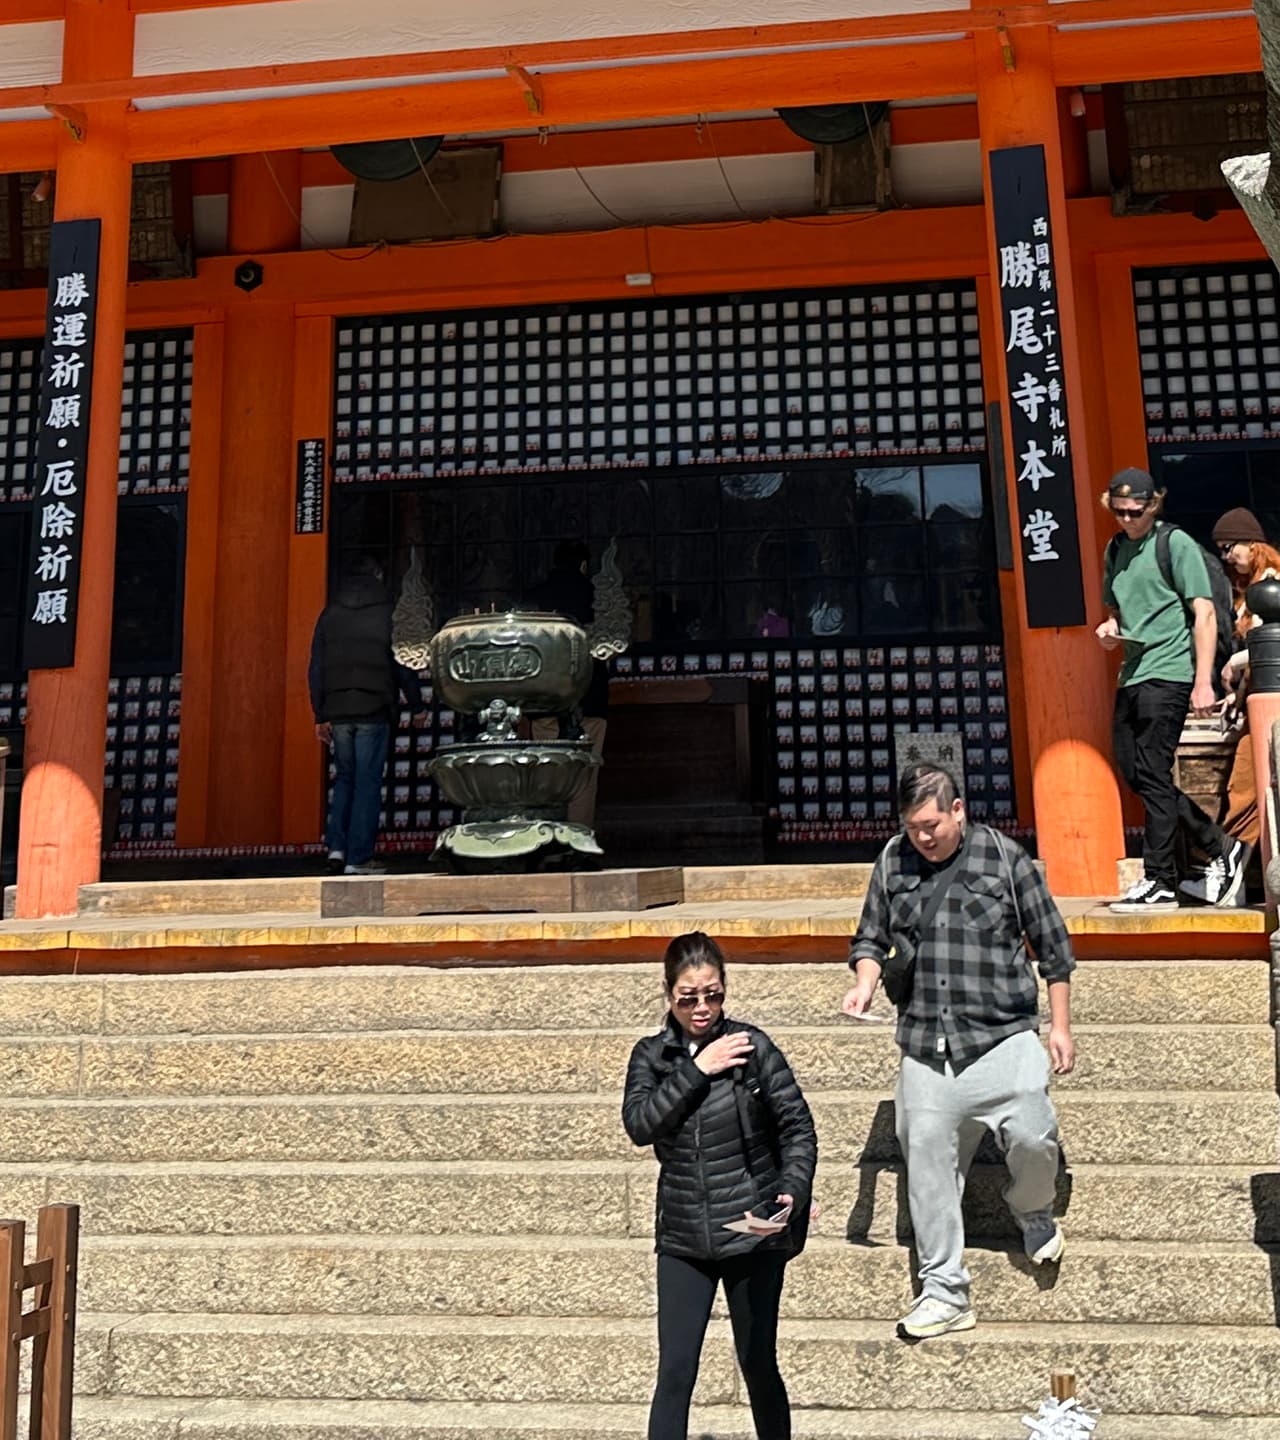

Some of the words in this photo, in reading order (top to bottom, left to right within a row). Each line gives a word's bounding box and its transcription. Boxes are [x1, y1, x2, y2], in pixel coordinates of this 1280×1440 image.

[31, 273, 90, 625] 勝運祈願・厄除祈願
[1000, 241, 1060, 563] 勝尾寺本堂
[1031, 216, 1068, 458] 西国第二十三番札所
